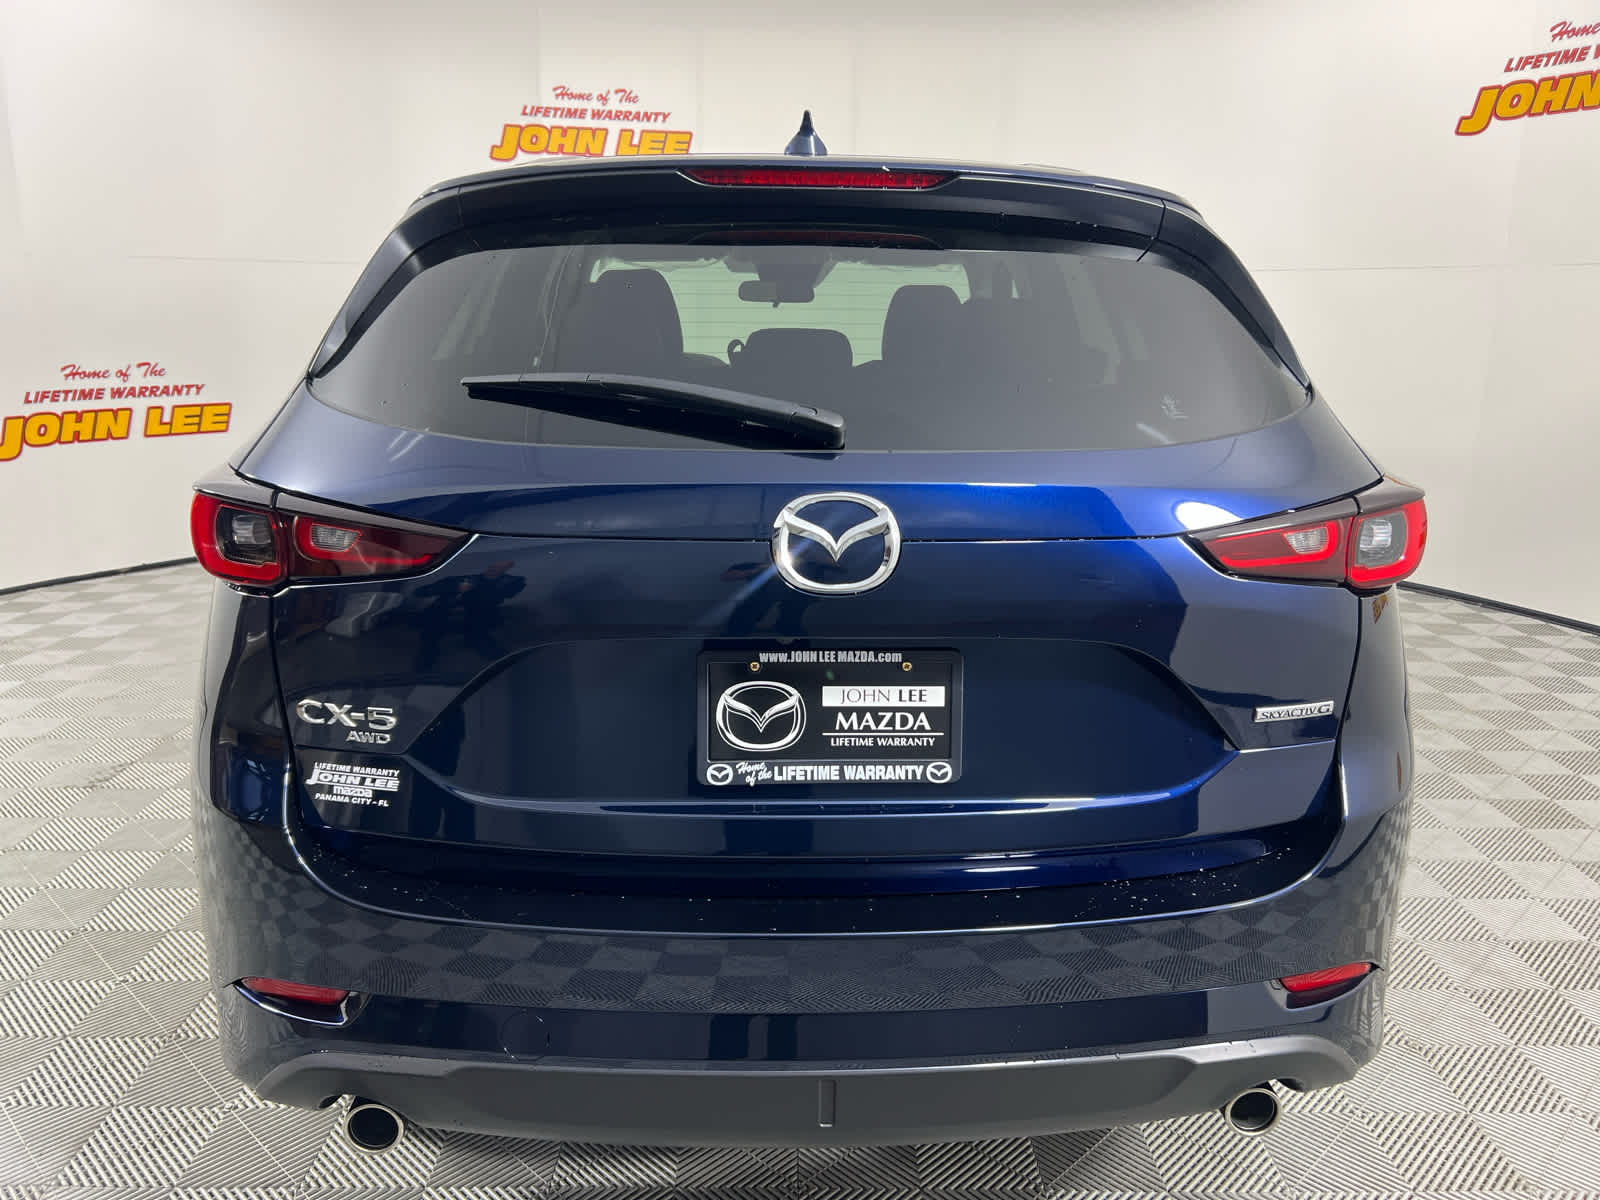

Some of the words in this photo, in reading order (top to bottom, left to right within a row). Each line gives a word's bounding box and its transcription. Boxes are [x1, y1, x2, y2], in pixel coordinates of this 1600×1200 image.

[1504, 45, 1592, 72] LIFETIME
[552, 85, 593, 101] Home
[597, 89, 609, 105] of
[614, 88, 639, 104] The
[1455, 70, 1600, 136] JOHN
[521, 105, 587, 119] LIFETIME
[591, 108, 671, 123] WARRANTY
[490, 123, 608, 162] JOHN
[616, 129, 693, 156] LEE
[60, 364, 110, 380] Home
[115, 365, 131, 383] of
[136, 362, 167, 377] The
[24, 387, 105, 404] LIFETIME
[110, 384, 206, 399] WARRANTY
[0, 408, 133, 462] JOHN
[144, 402, 233, 438] LEE
[840, 688, 890, 704] JOHN
[898, 689, 928, 703] LEE
[296, 699, 398, 730] CX-5
[835, 711, 931, 731] MAZDA
[346, 730, 391, 744] AWD
[830, 737, 874, 747] LIFETIME
[876, 737, 936, 747] WARRANTY
[314, 762, 352, 773] LIFETIME
[352, 766, 400, 777] WARRANTY
[735, 761, 766, 775] Home
[745, 771, 757, 787] of
[757, 768, 773, 780] the
[774, 765, 841, 781] LIFETIME
[843, 765, 924, 781] WARRANTY
[305, 768, 361, 786] JOHN
[364, 778, 400, 789] LEE
[315, 793, 349, 804] PANAMA
